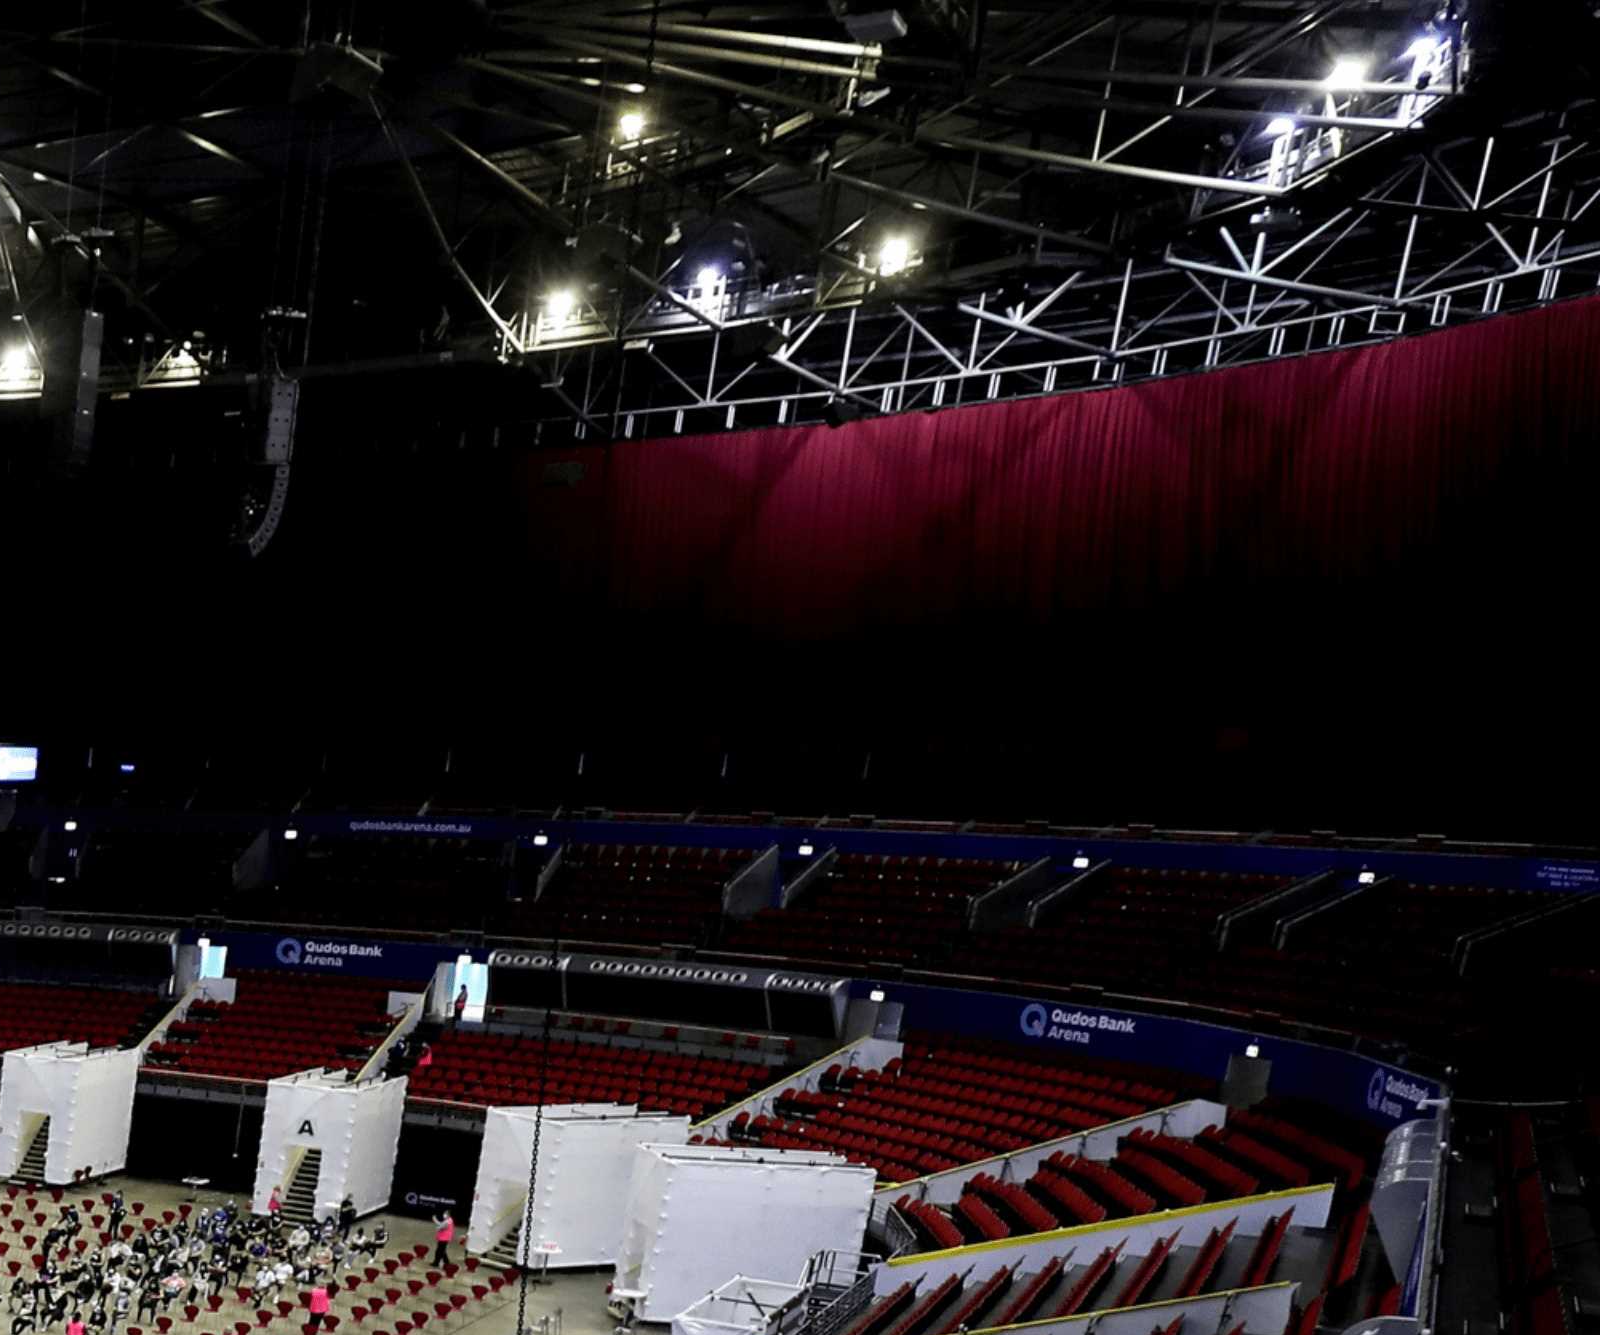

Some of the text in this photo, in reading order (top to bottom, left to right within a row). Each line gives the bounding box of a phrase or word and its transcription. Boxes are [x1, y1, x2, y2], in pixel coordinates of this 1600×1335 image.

[304, 940, 383, 958] Qudos Bank
[303, 954, 343, 968] Arena
[1051, 1008, 1136, 1034] Qudos Bank
[1046, 1025, 1091, 1044] Arena
[297, 1120, 314, 1136] A
